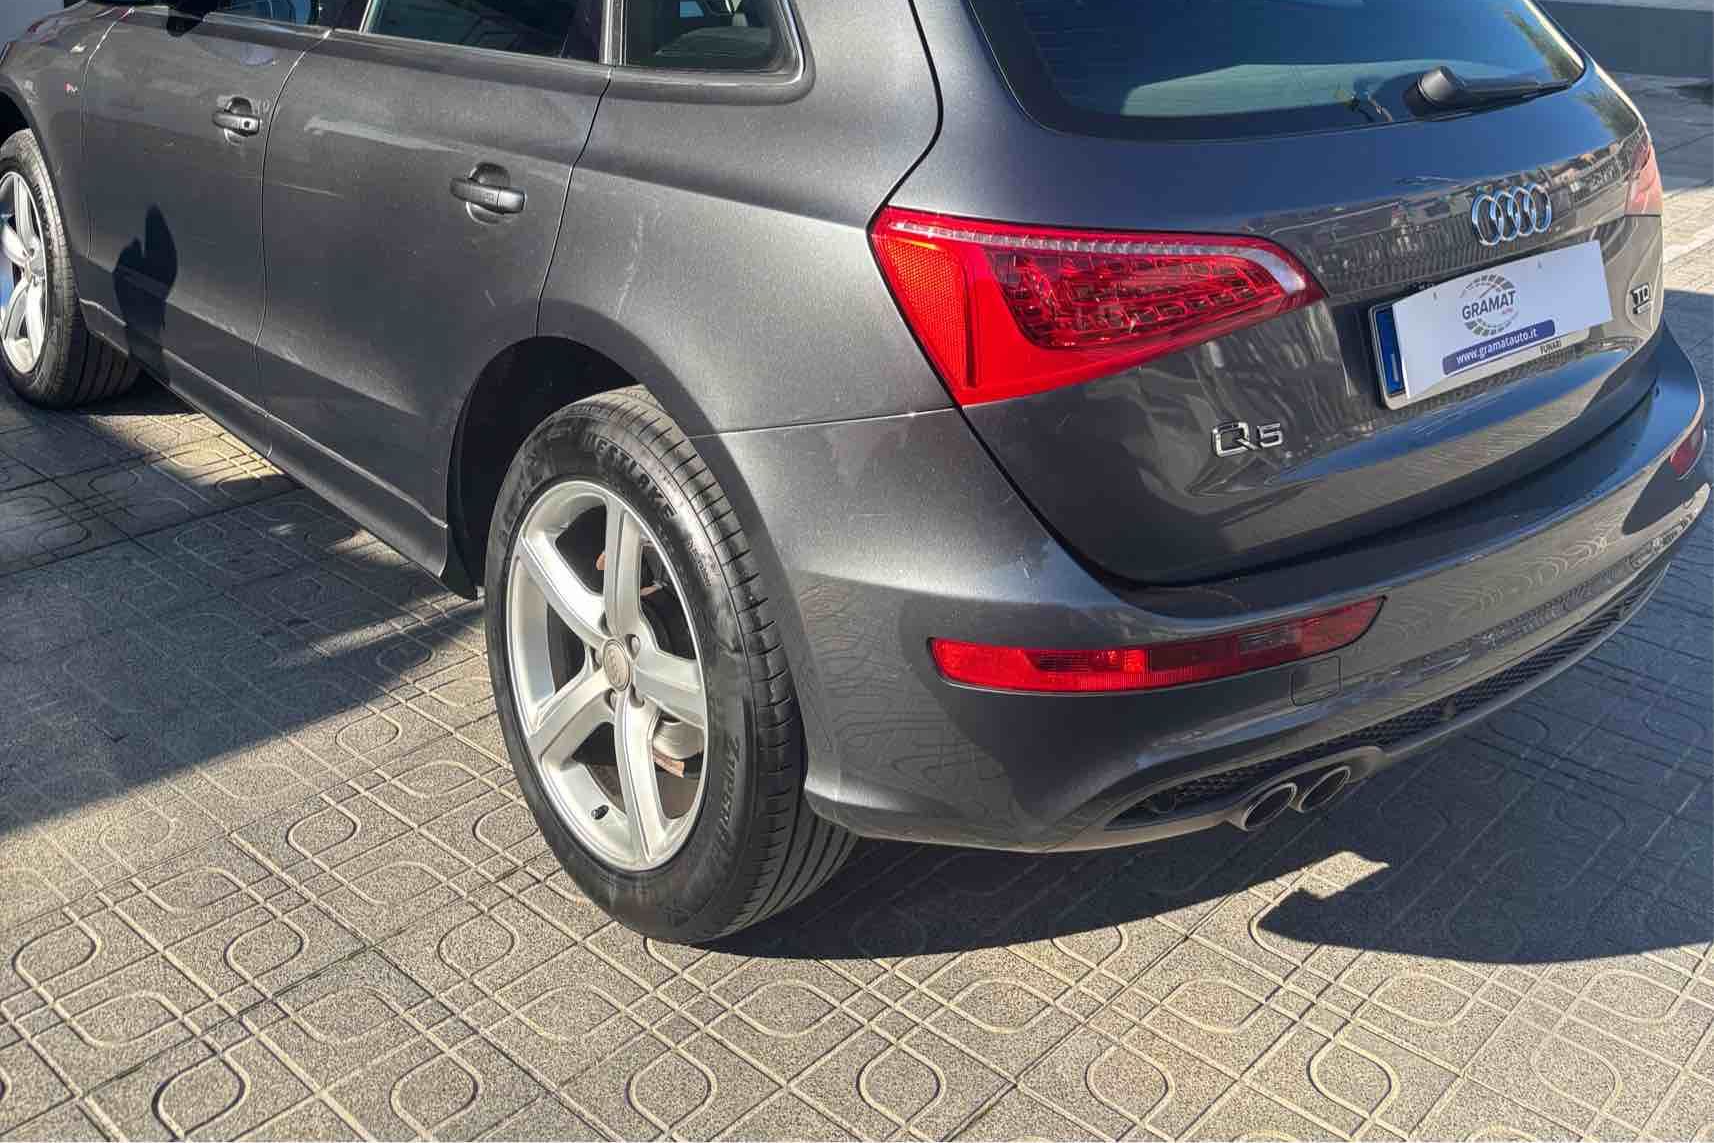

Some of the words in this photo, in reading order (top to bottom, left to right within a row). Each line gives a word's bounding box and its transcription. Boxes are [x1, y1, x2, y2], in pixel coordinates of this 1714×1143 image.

[1462, 289, 1516, 320] GRAMAT
[1455, 327, 1538, 365] www.gramatauto.it
[1210, 422, 1283, 458] Q5
